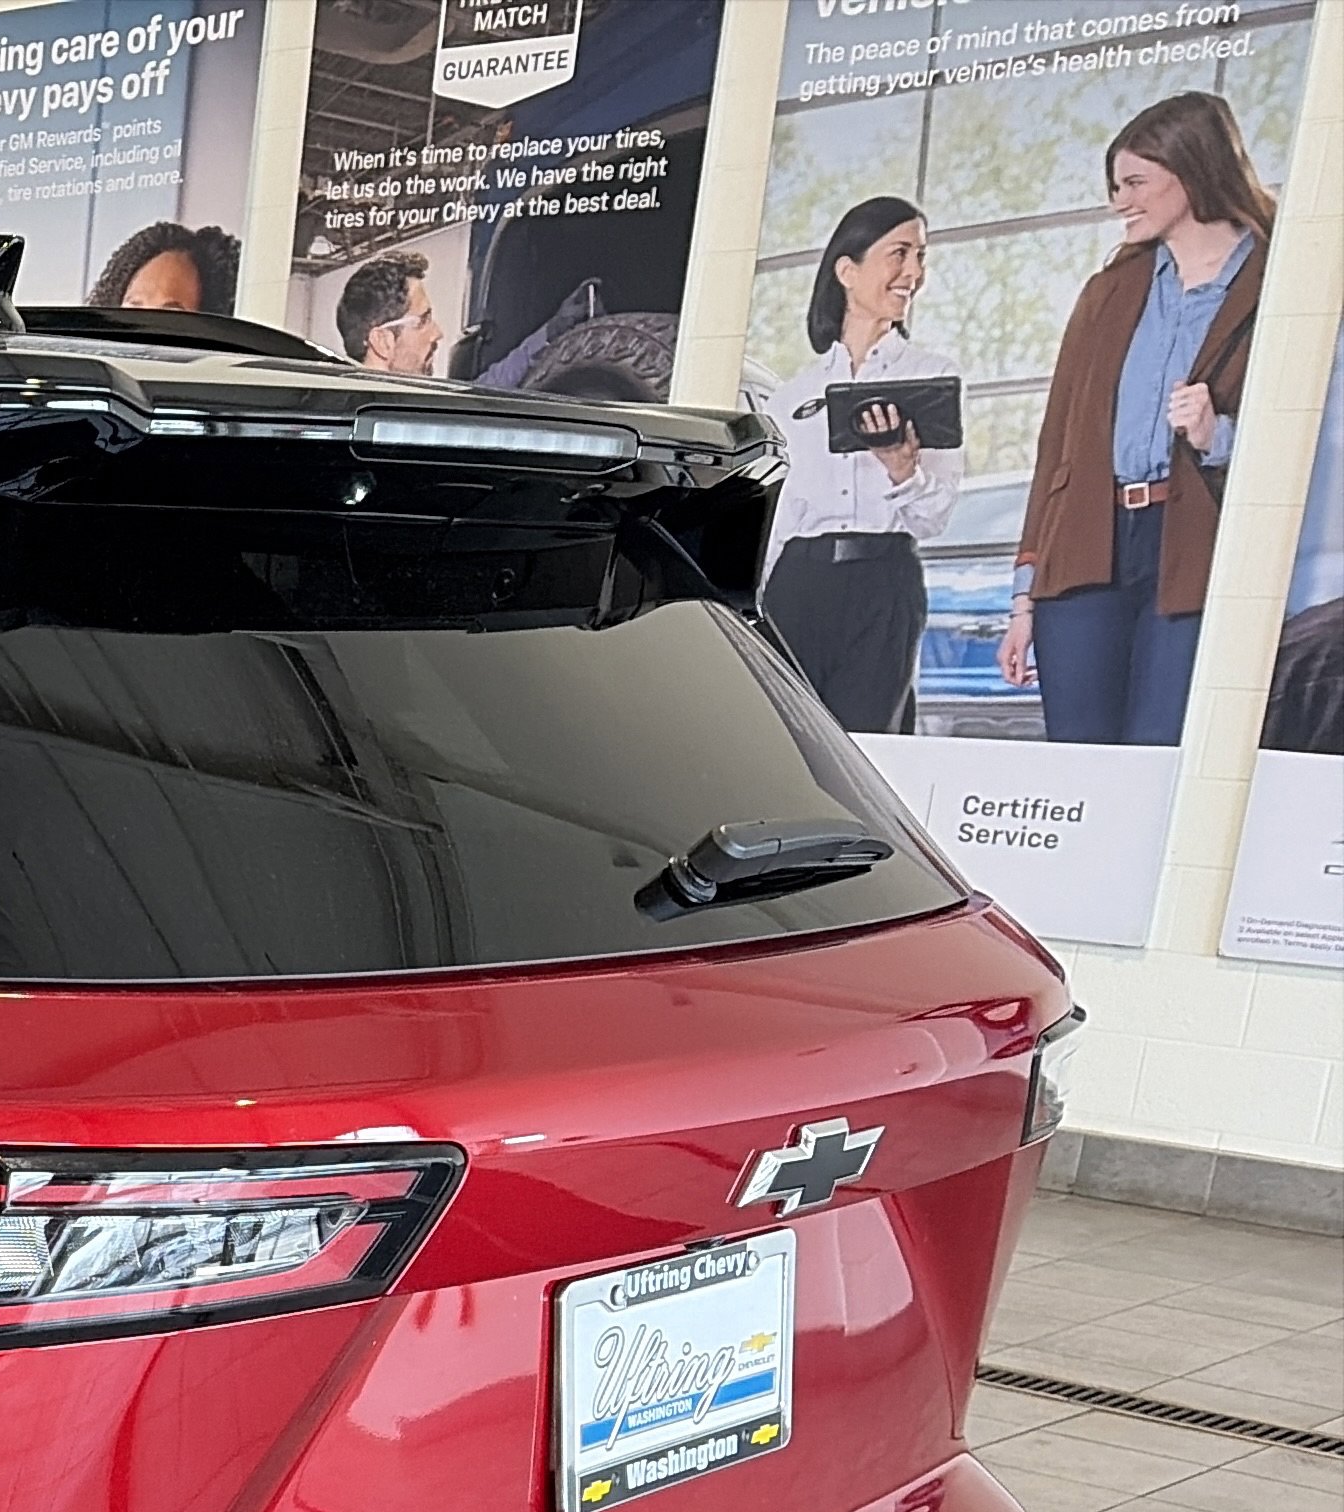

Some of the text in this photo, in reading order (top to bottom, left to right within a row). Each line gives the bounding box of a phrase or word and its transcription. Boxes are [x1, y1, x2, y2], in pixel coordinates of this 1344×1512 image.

[51, 29, 119, 65] care
[127, 14, 162, 55] of
[167, 8, 244, 57] your
[473, 2, 548, 32] MATCH
[805, 2, 1240, 66] The peace of mind that comes from
[442, 49, 570, 81] GUARANTEE
[799, 32, 1256, 103] getting your vehicle's health checked.
[42, 75, 114, 118] pays
[120, 57, 172, 101] off
[9, 131, 33, 151] GM
[111, 118, 162, 143] points
[28, 153, 87, 173] Service,
[90, 144, 160, 168] including
[163, 138, 183, 159] oil
[333, 126, 666, 172] When it's time to replace your tires,
[8, 183, 32, 202] tire
[35, 176, 102, 201] rotations
[105, 172, 135, 193] and
[137, 169, 184, 188] more.
[326, 155, 669, 201] let us do the work. We have the right
[324, 186, 661, 230] tires for your Chevy at the best deal.
[961, 794, 1085, 824] Certified
[957, 822, 1060, 850] Service
[625, 1251, 747, 1300] Uftring Chevy
[627, 1399, 693, 1429] WASHINGTON
[625, 1431, 739, 1490] Washington
